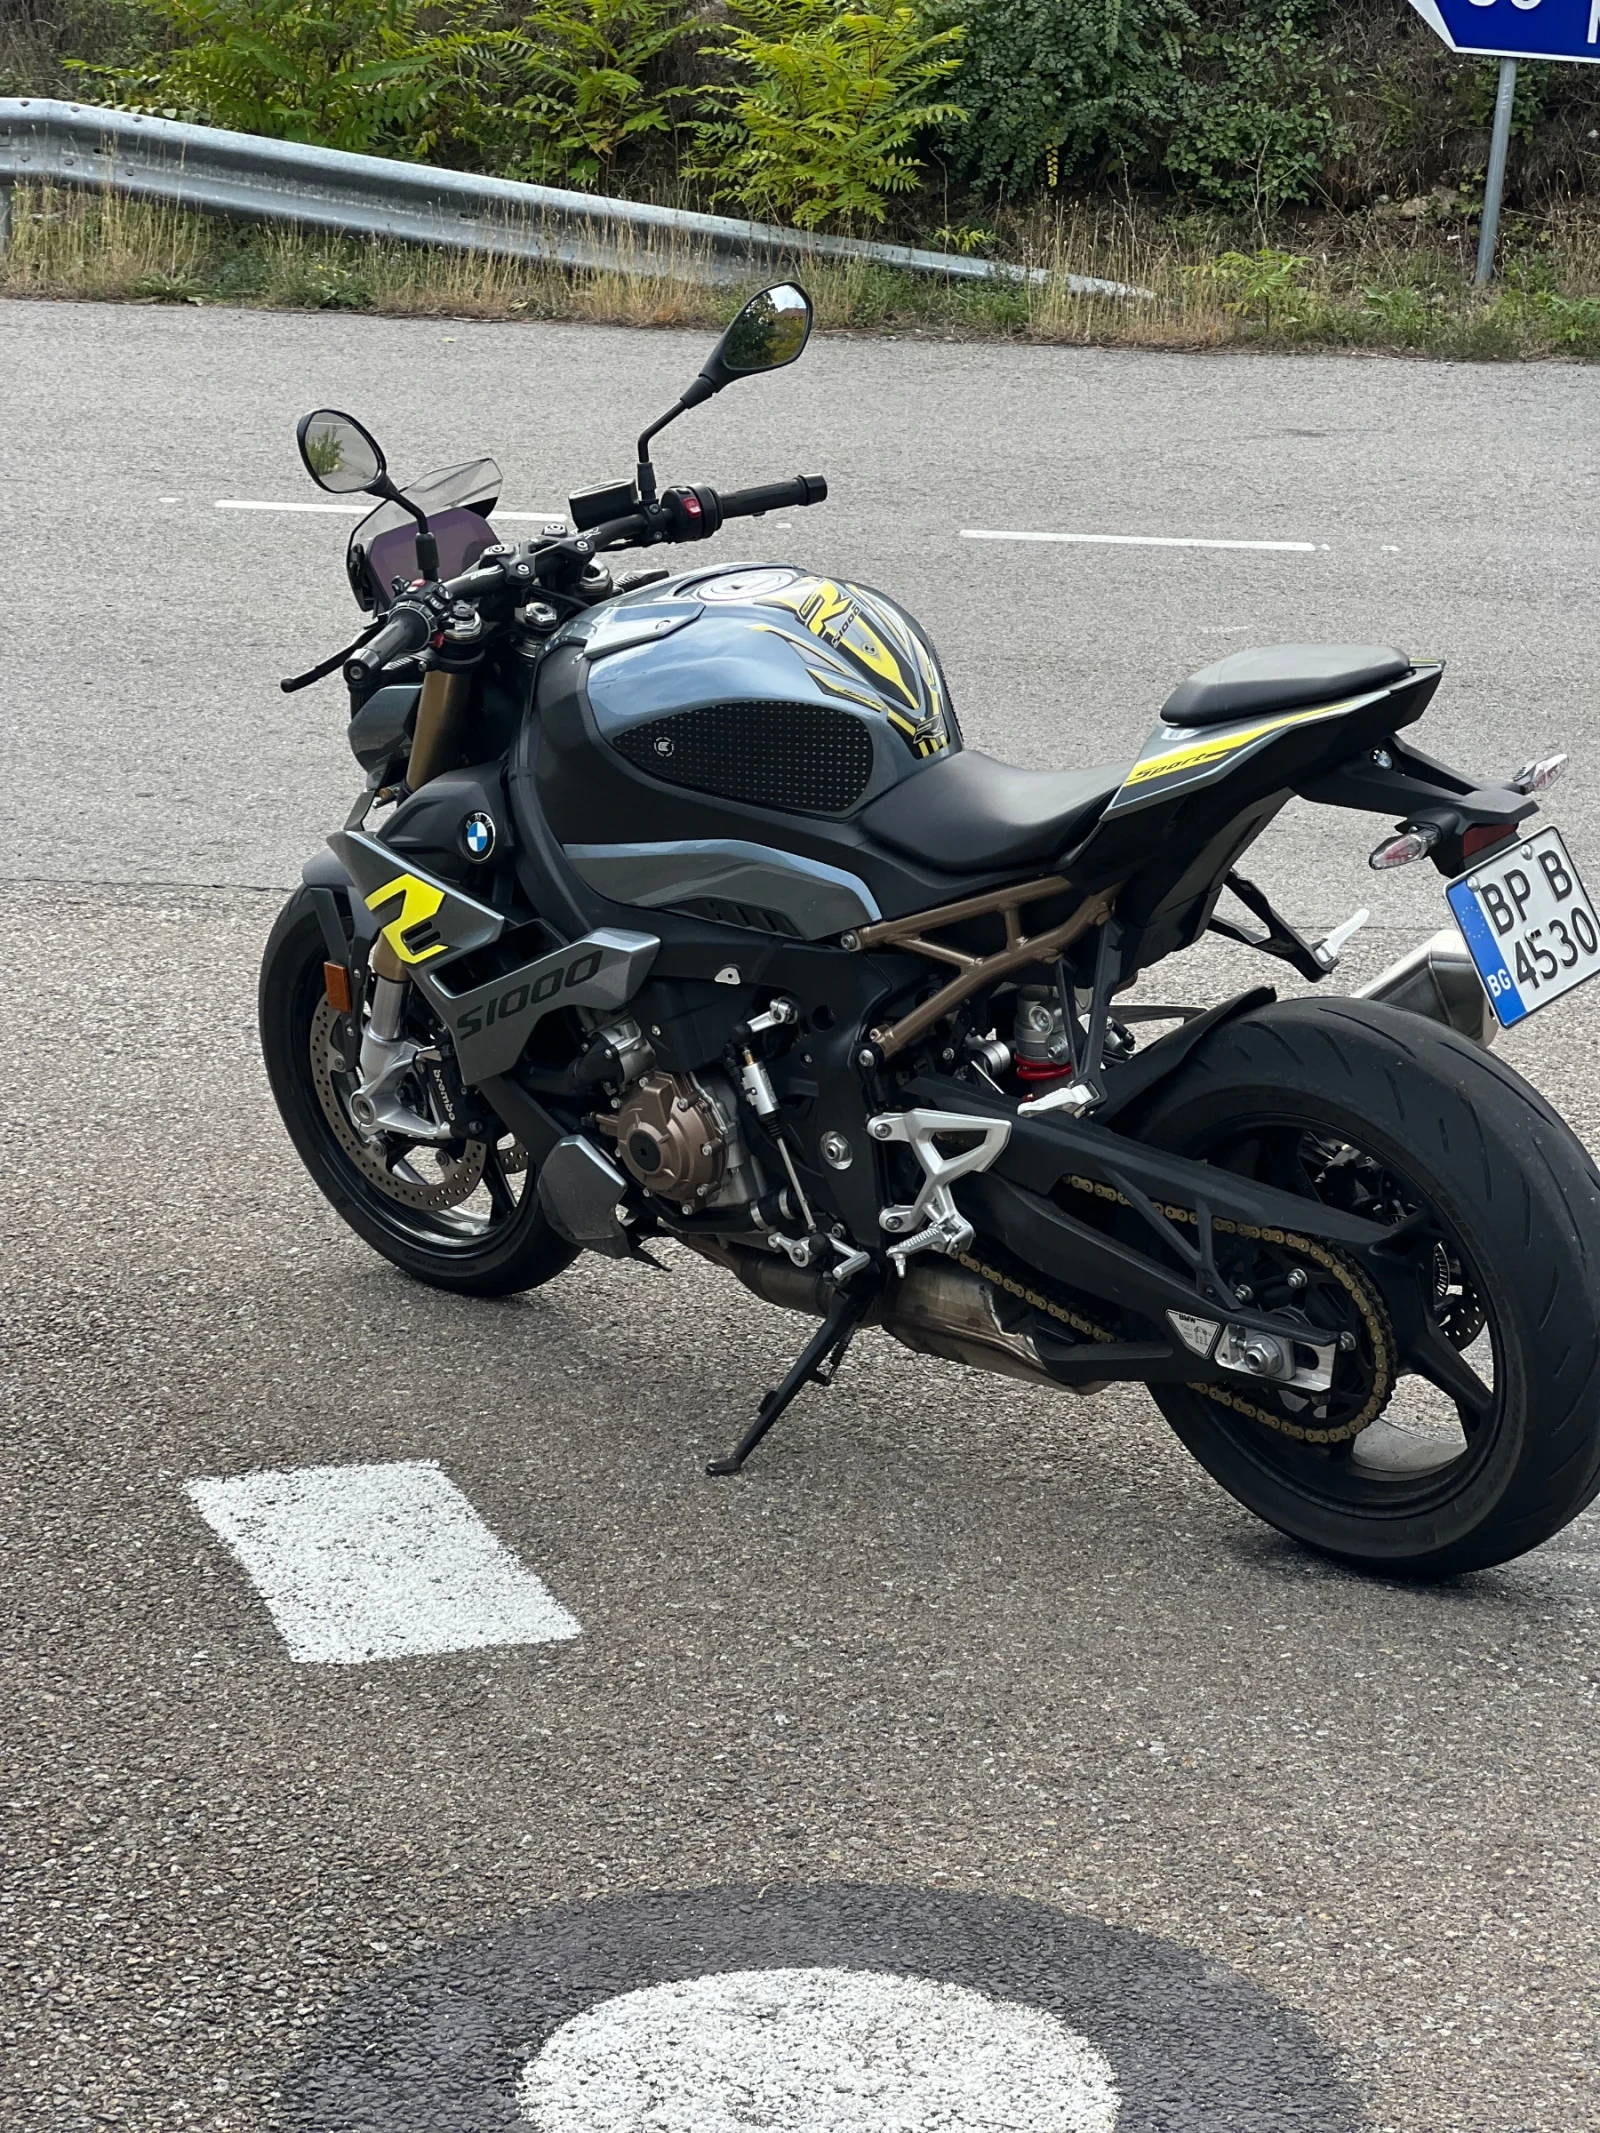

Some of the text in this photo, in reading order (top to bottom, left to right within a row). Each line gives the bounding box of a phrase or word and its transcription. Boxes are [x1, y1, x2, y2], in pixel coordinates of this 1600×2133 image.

[1480, 849, 1573, 937] BP B
[1486, 968, 1512, 998] BG
[1514, 906, 1598, 990] 4530
[457, 950, 604, 1042] S1000
[432, 1068, 456, 1122] brembo
